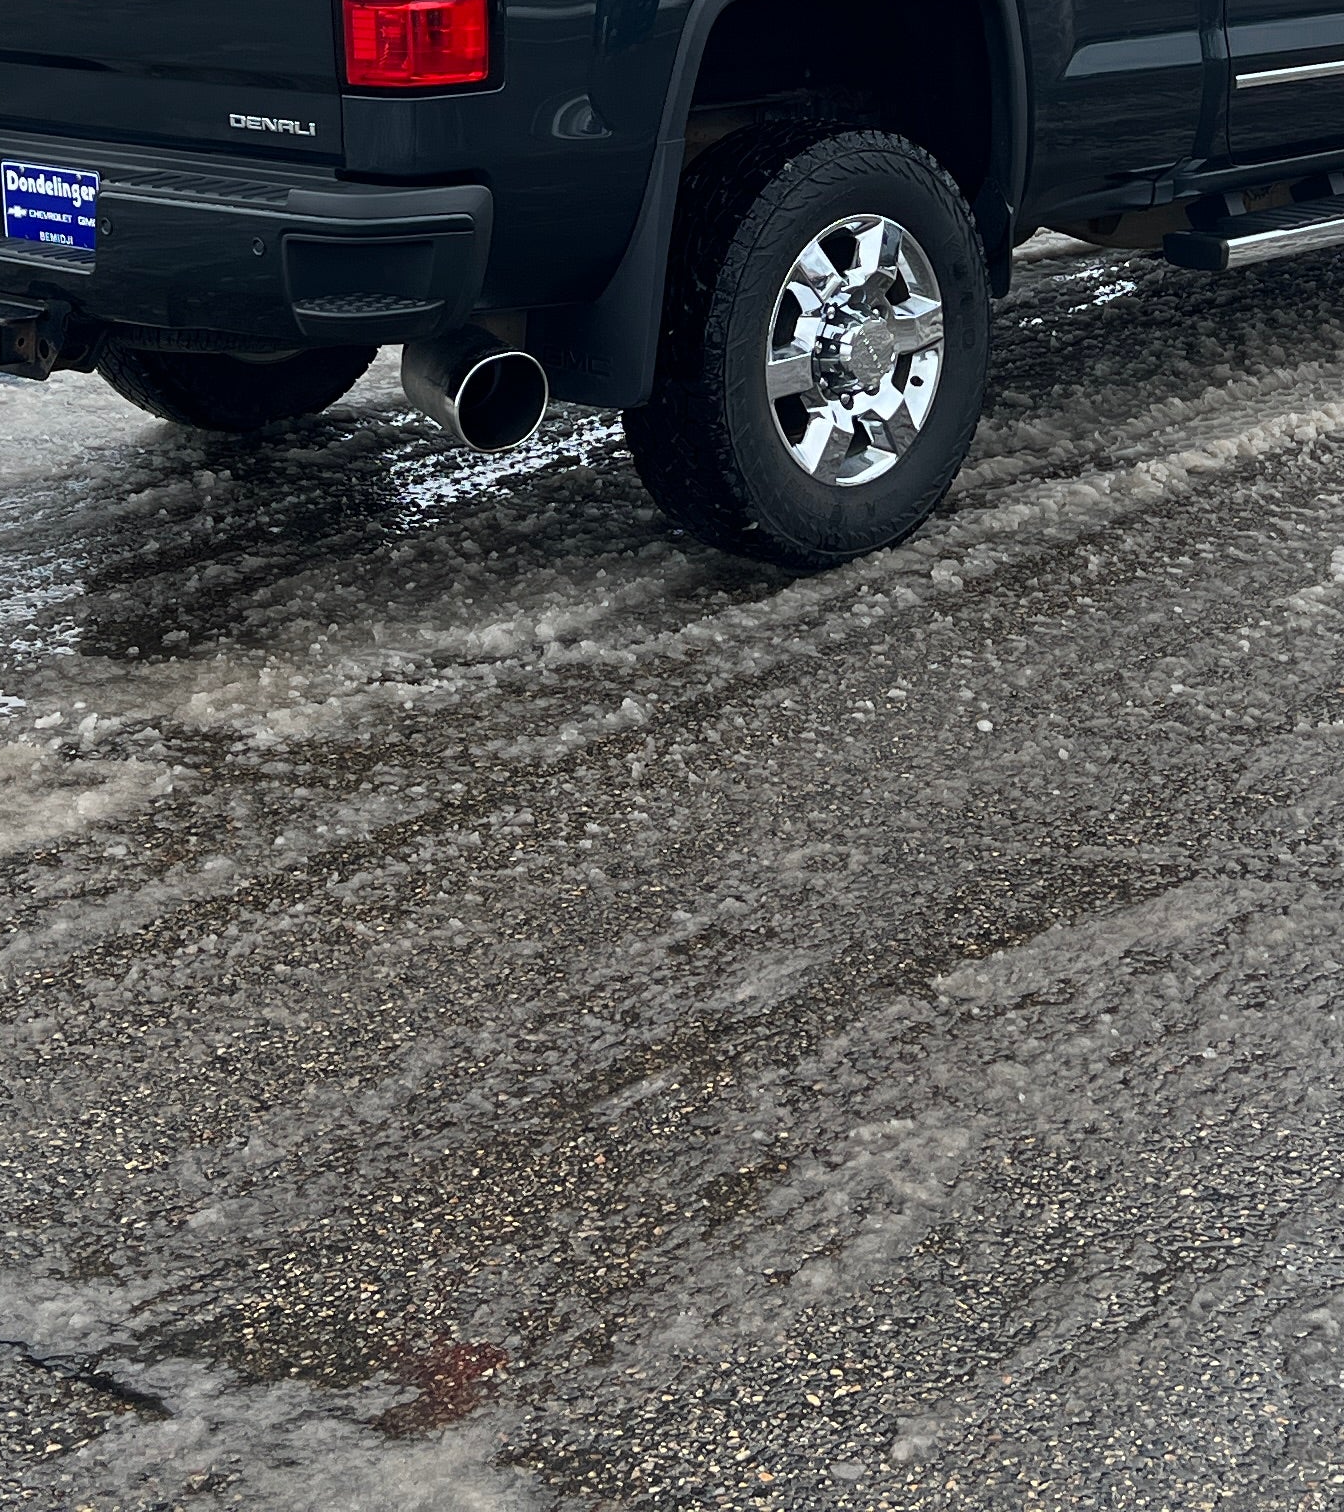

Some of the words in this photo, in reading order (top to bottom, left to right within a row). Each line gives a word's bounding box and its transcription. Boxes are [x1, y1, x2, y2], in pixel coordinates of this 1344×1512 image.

[229, 113, 316, 137] DENALI
[6, 169, 96, 208] Dondelinger
[28, 209, 73, 224] CHEVROLET
[39, 230, 74, 245] BEMIDJI
